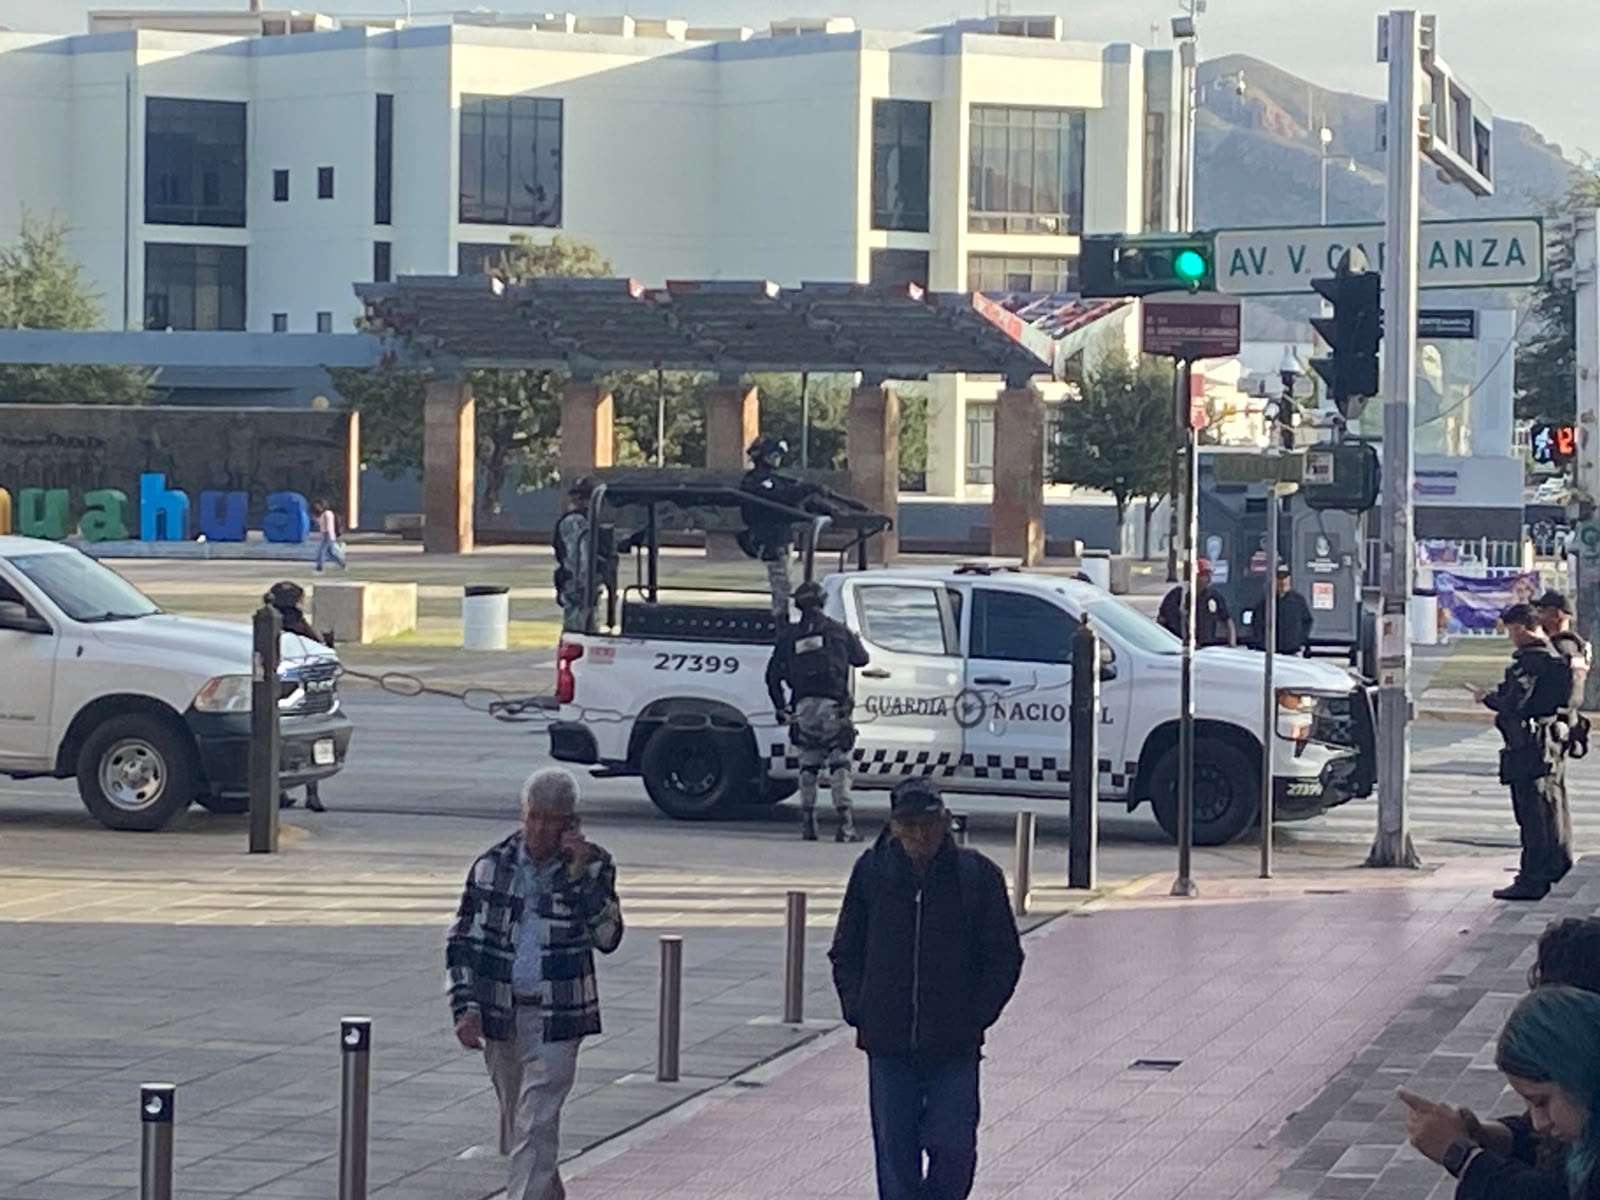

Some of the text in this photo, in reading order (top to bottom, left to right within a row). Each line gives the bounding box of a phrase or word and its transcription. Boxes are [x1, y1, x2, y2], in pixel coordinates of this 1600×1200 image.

[1228, 246, 1275, 277] AV.
[1287, 244, 1312, 274] V.
[0, 471, 310, 542] uahua
[653, 652, 740, 675] 27399
[865, 695, 1114, 725] GUARDIA NACIOL
